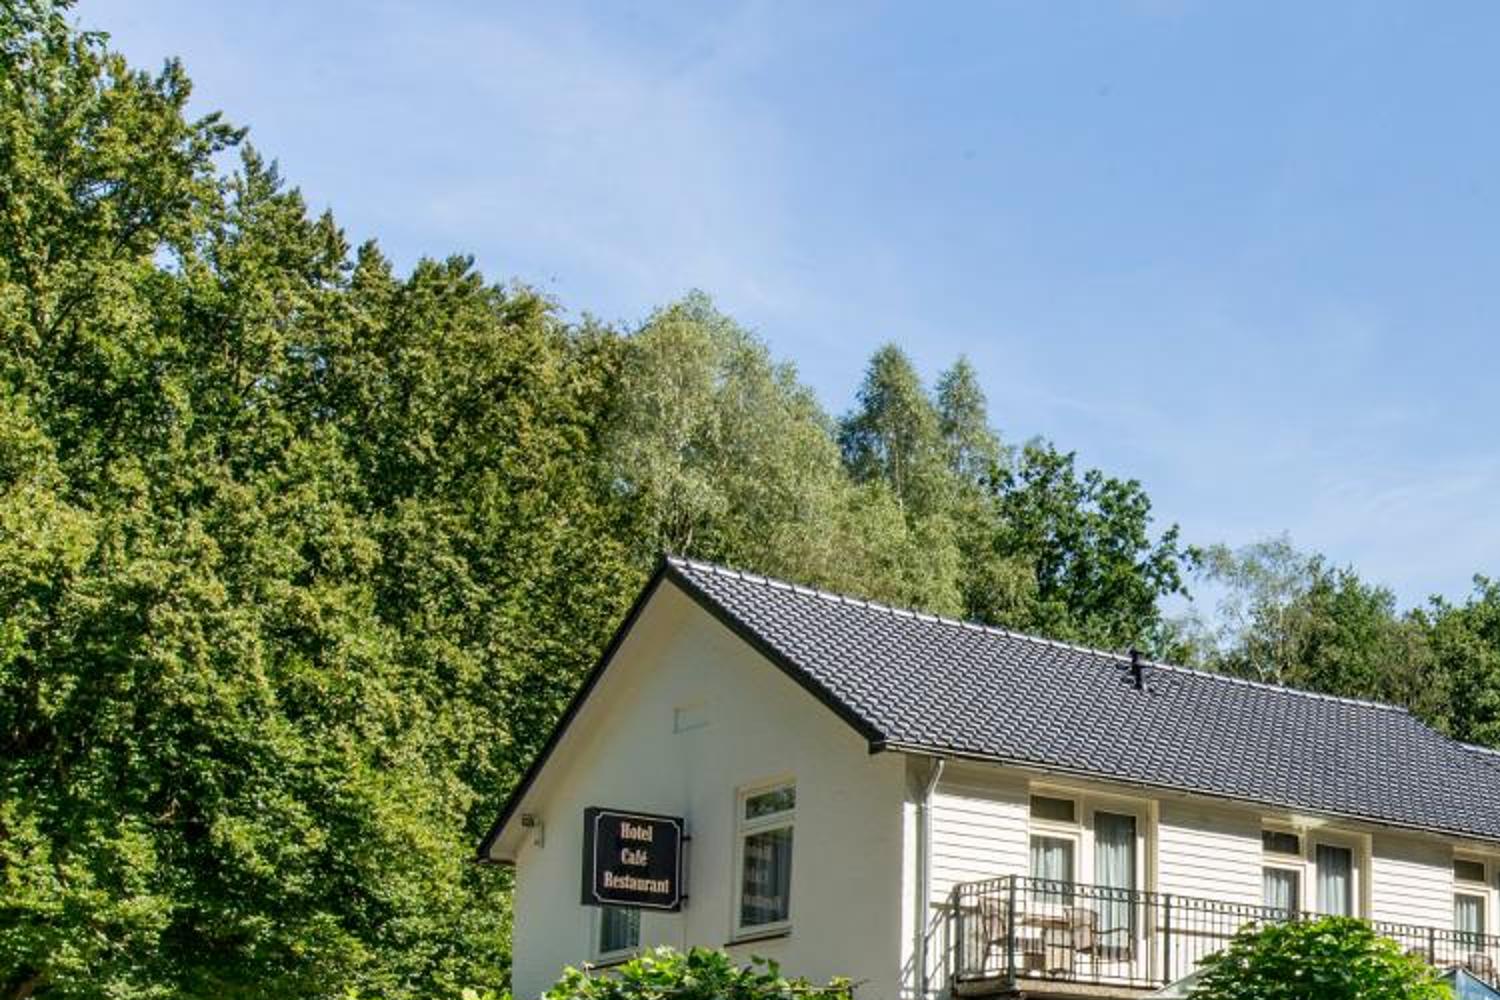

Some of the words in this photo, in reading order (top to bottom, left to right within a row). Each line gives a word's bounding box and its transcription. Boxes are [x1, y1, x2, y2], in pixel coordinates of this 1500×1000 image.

[621, 822, 653, 842] Hotel
[621, 847, 648, 866] Café
[604, 871, 669, 893] Restaurant
